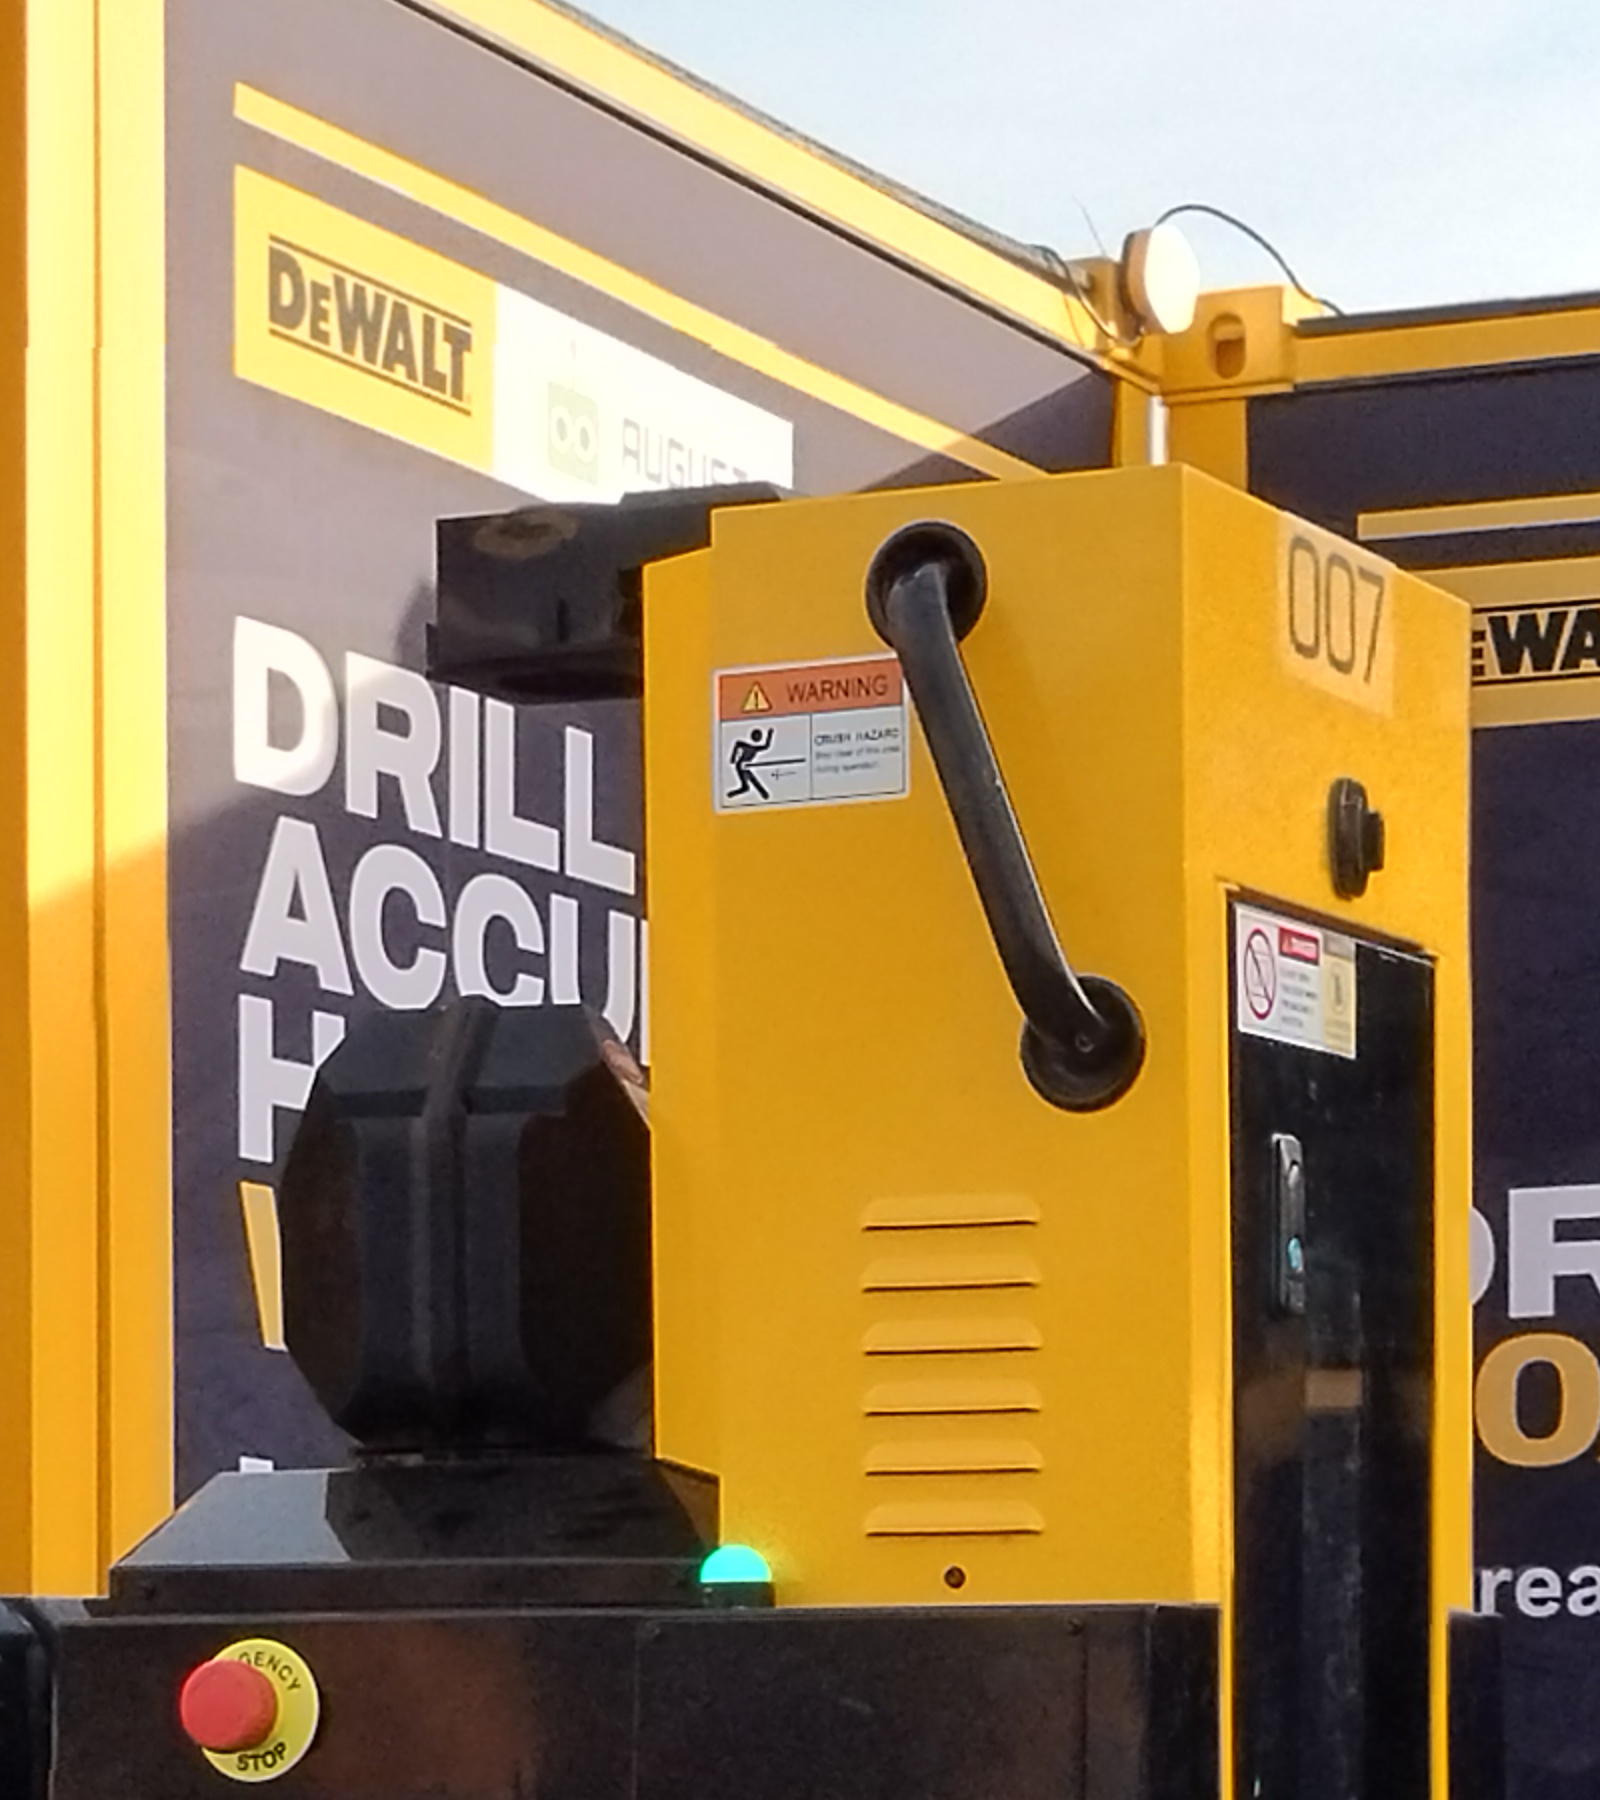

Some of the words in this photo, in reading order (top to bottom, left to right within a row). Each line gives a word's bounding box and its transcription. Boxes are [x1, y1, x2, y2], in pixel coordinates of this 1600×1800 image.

[1288, 534, 1386, 684] 007
[234, 614, 636, 895] DRILL
[786, 674, 889, 704] WARNING
[239, 815, 649, 1062] ACCU
[236, 1741, 286, 1772] STOP
